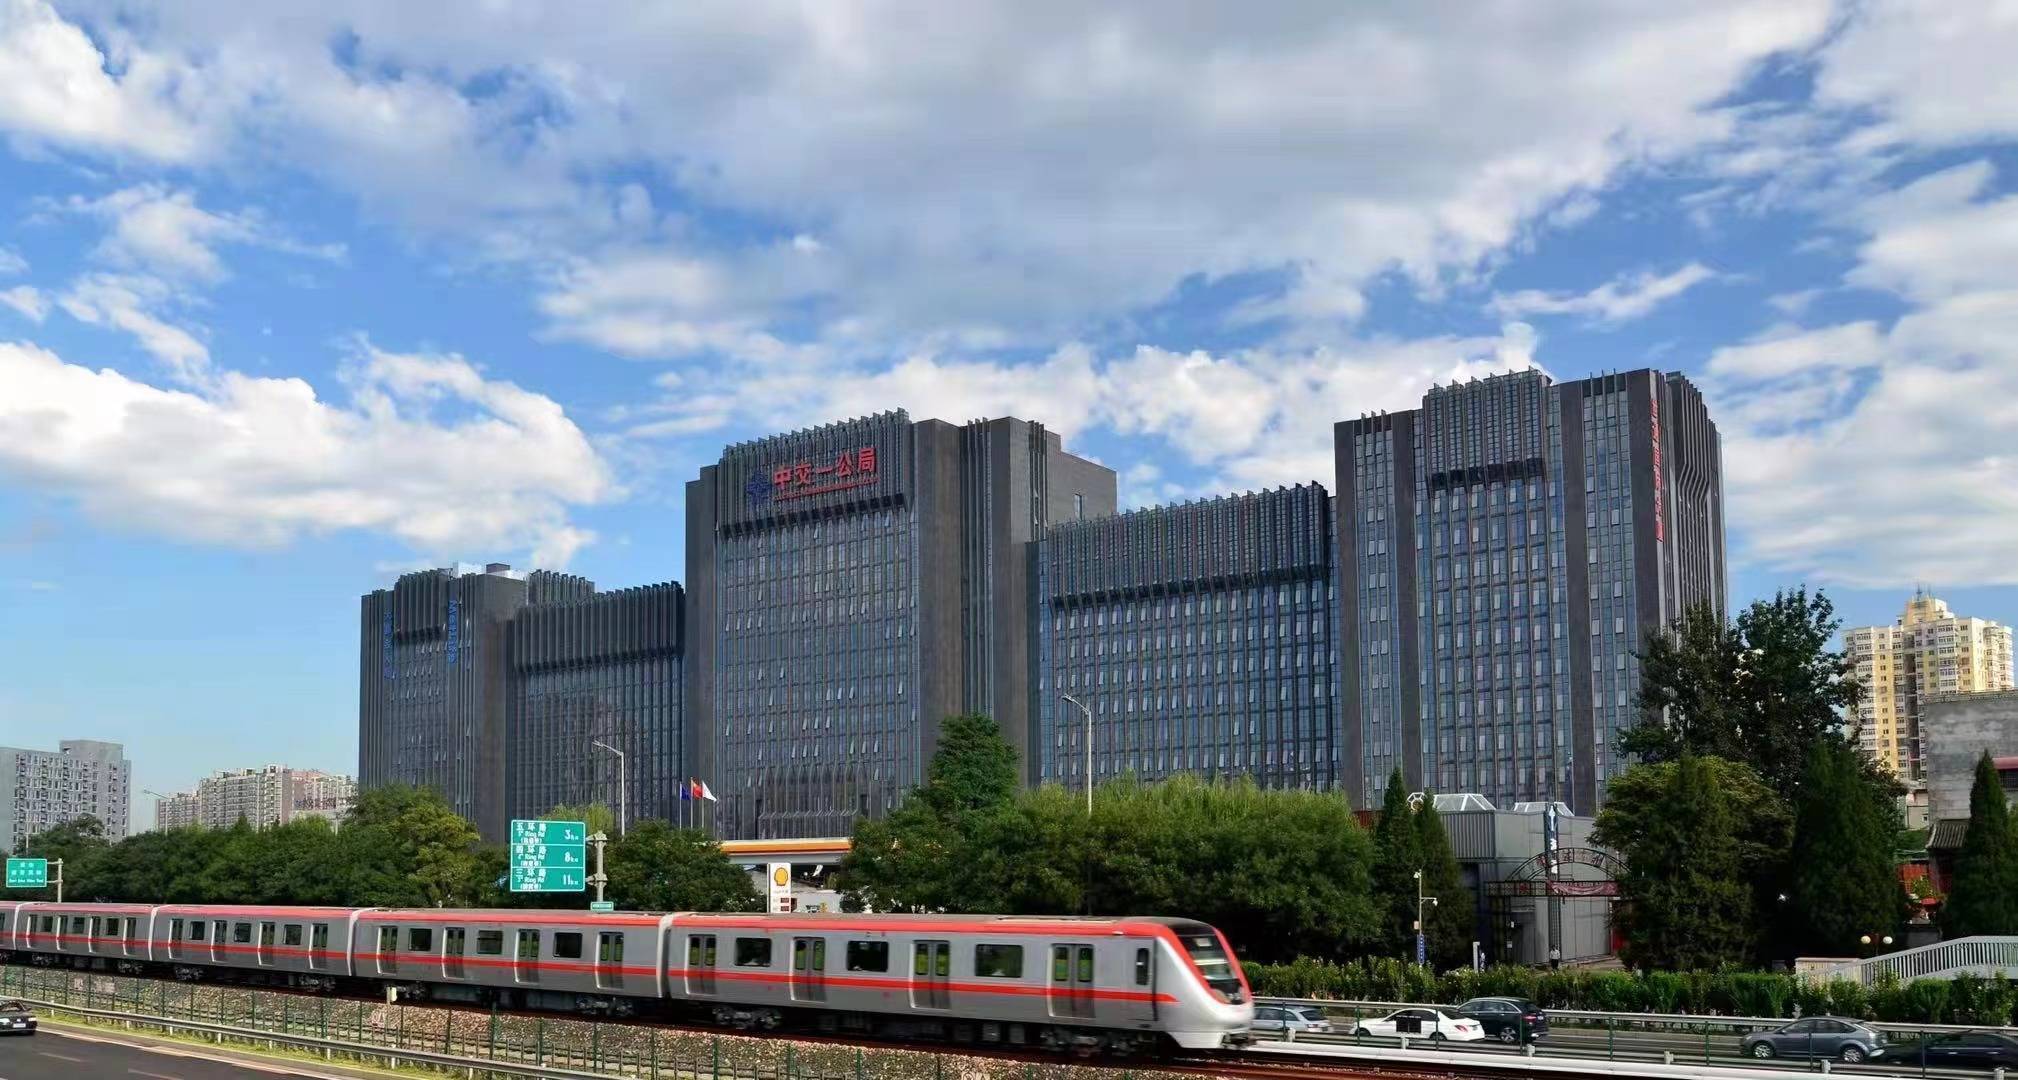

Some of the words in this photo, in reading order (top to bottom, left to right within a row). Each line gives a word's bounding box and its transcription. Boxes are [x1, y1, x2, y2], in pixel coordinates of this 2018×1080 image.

[773, 447, 877, 490] 中交一公局
[516, 822, 547, 832] 五环路
